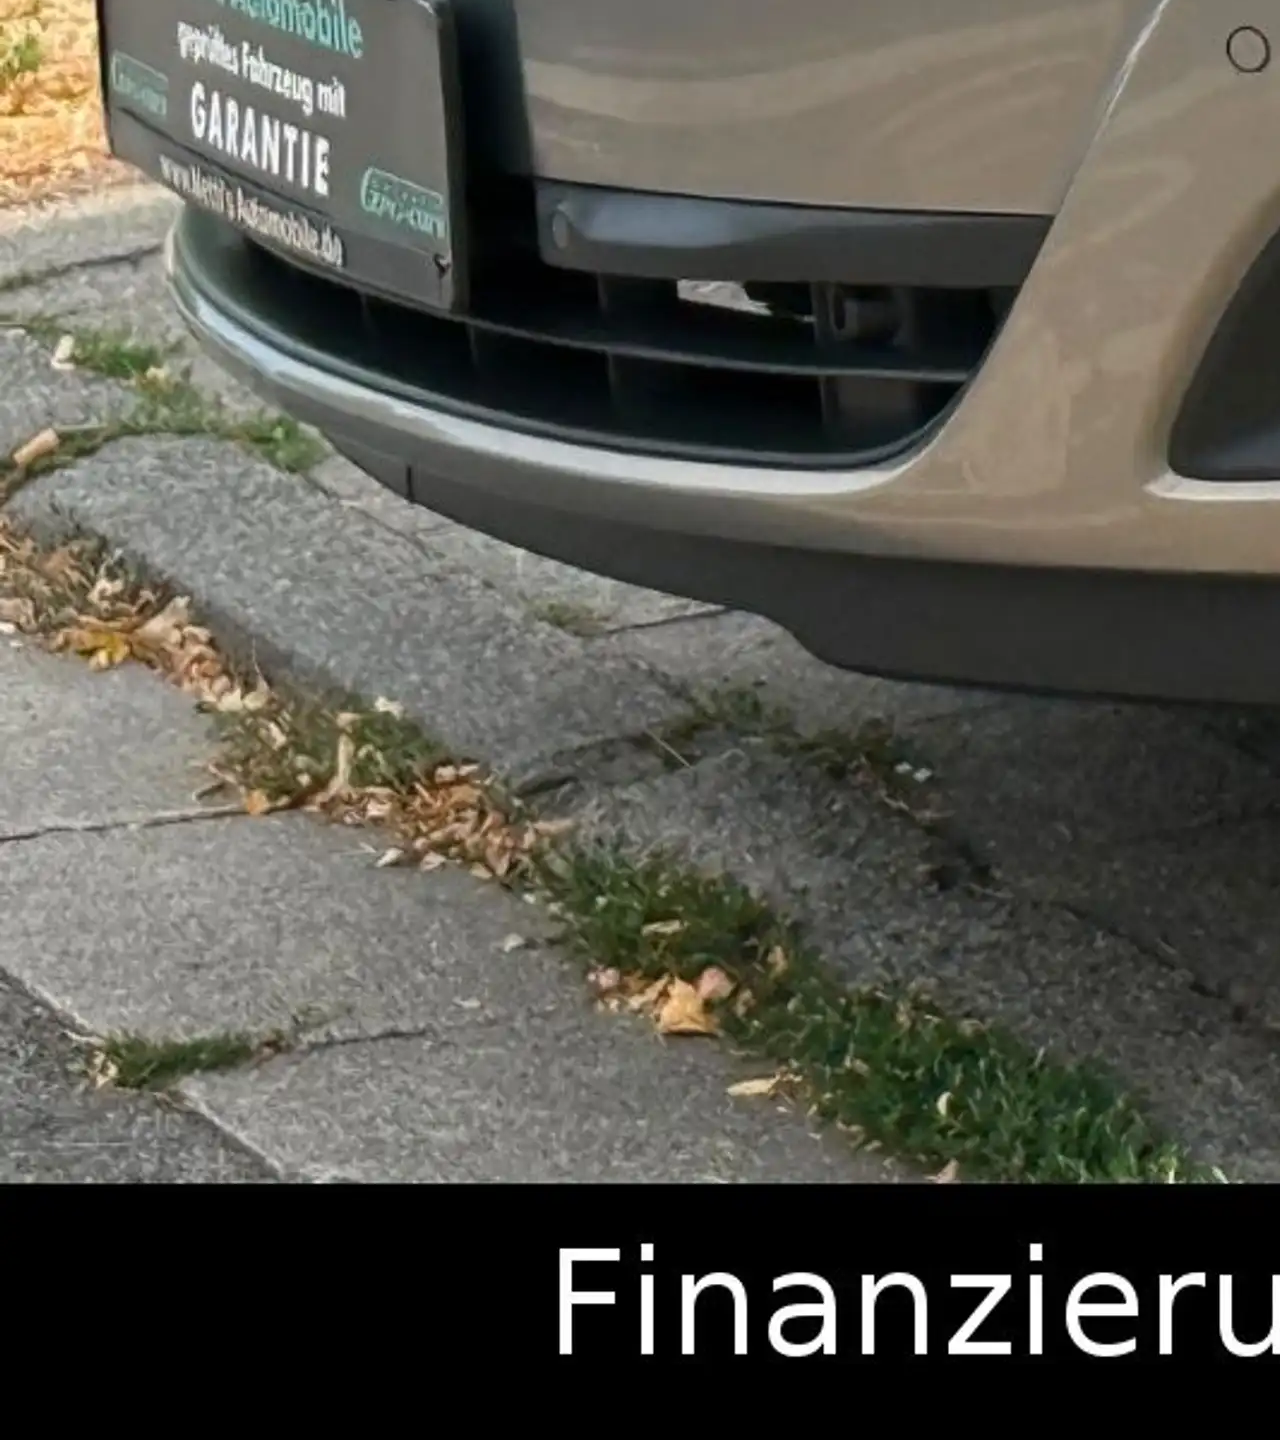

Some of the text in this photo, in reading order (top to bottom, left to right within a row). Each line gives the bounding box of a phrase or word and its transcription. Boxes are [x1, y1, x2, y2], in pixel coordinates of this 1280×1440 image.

[242, 40, 314, 117] Fahrzeug
[316, 75, 346, 119] mit
[190, 80, 331, 197] GARANTIE
